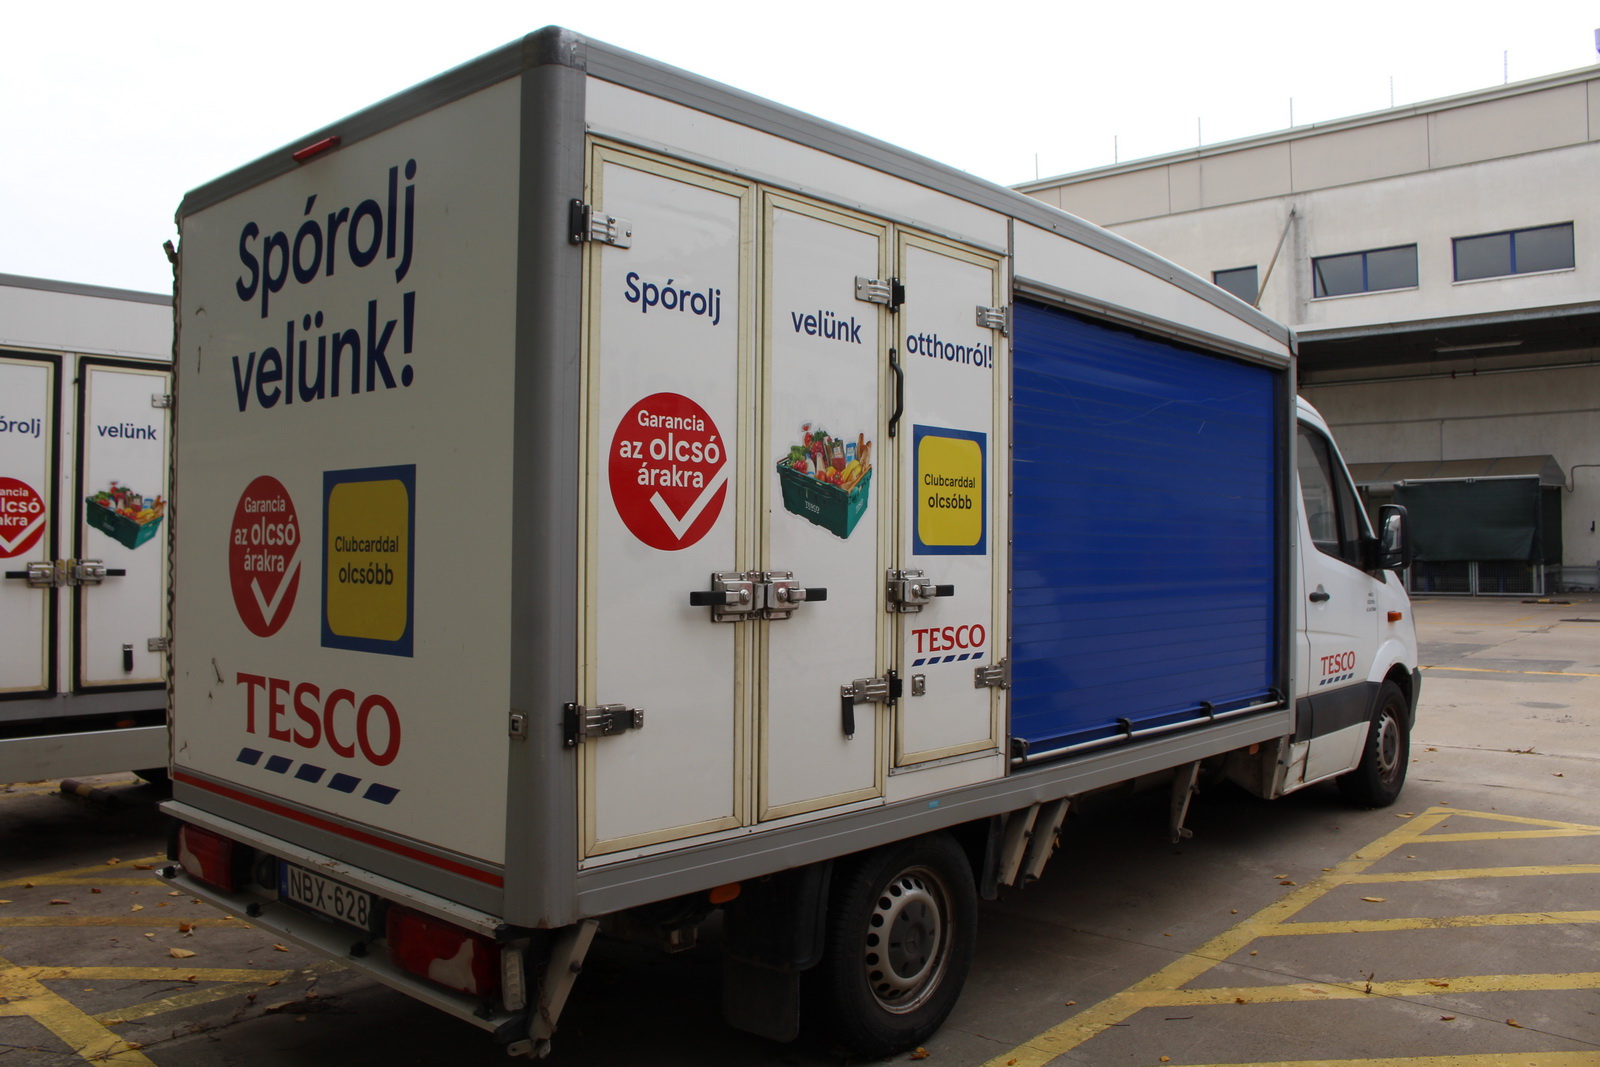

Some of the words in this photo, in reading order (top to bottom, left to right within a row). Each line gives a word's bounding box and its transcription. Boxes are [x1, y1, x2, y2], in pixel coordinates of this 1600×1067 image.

[236, 158, 417, 319] Spórolj
[624, 271, 721, 326] Spórolj
[791, 310, 862, 344] velünk
[906, 332, 992, 369] otthonról!
[232, 291, 416, 412] velünk!
[97, 423, 157, 441] velünk
[637, 409, 705, 432] Garancia
[619, 440, 643, 459] az
[650, 432, 720, 464] olcsó
[637, 463, 704, 488] árakra
[924, 473, 976, 488] Clubcarddal
[244, 495, 286, 513] Garancia
[928, 493, 973, 510] olcsóbb
[234, 527, 248, 545] az
[251, 515, 296, 546] olcsó
[335, 535, 399, 553] Clubcarddal
[244, 548, 285, 573] árakra
[338, 562, 394, 585] olcsóbb
[911, 623, 986, 654] TESCO
[1320, 650, 1356, 676] TESCO
[236, 671, 401, 767] TESCO
[290, 868, 367, 926] NBX-628
